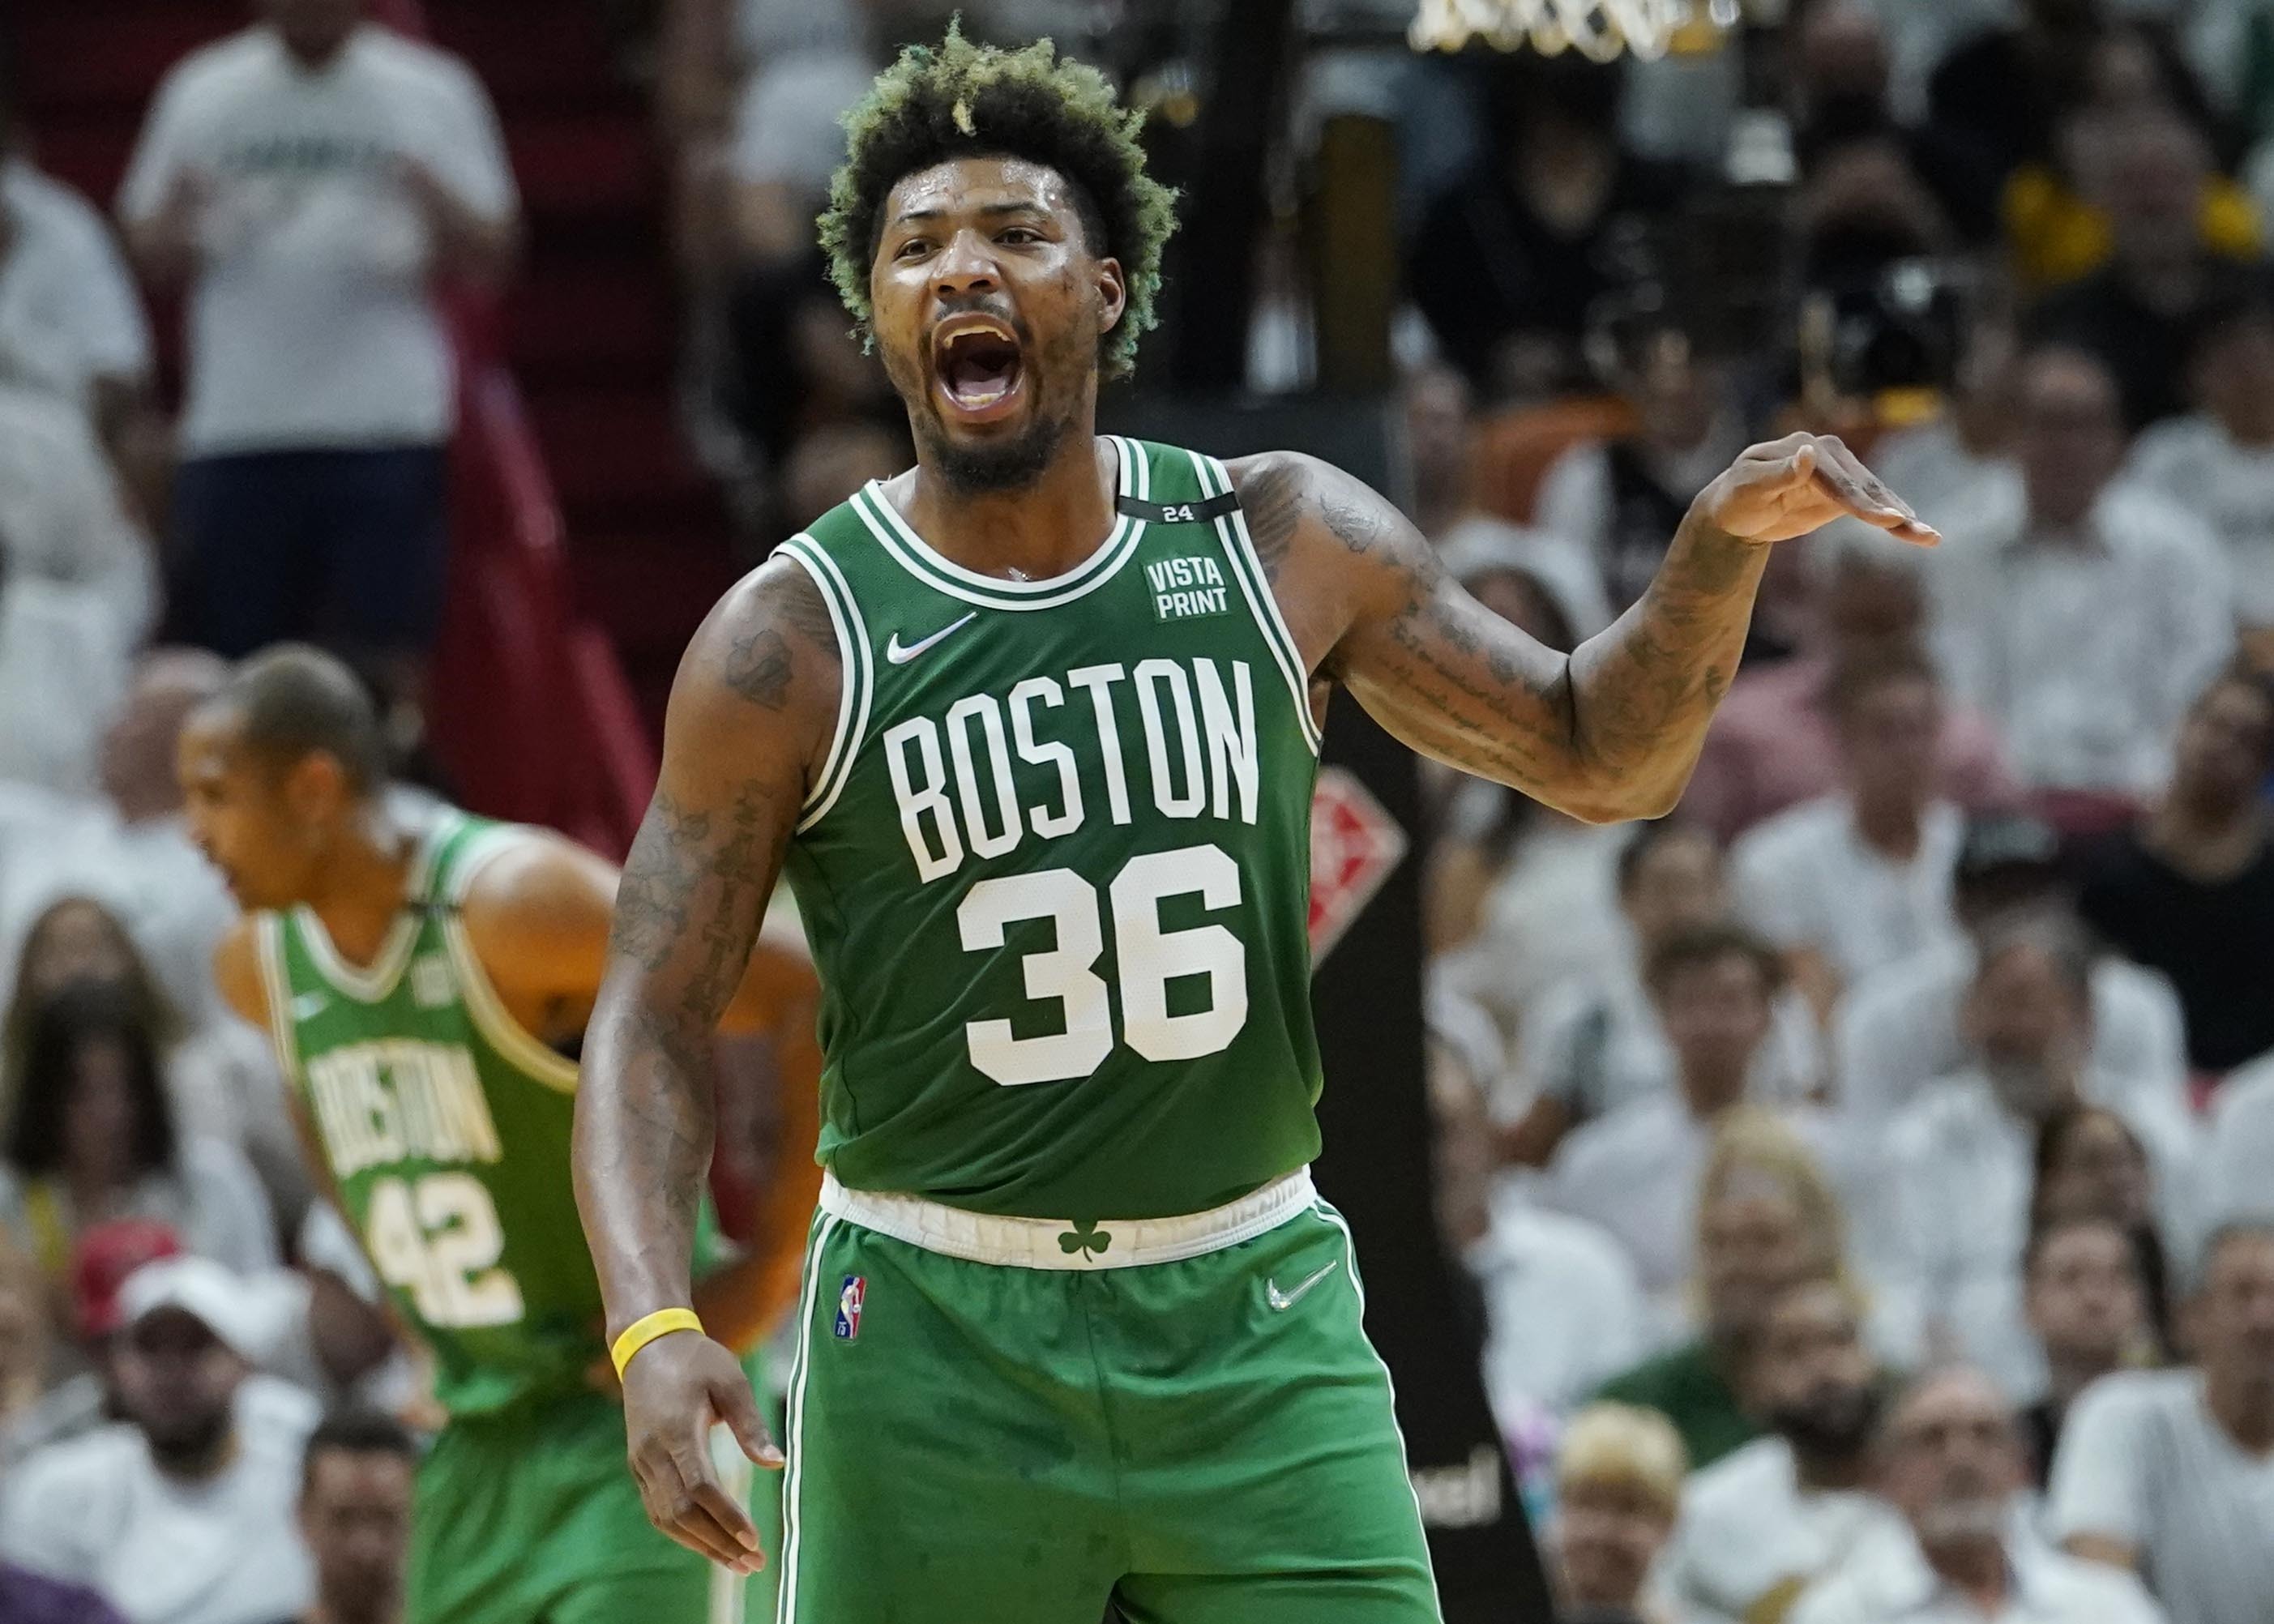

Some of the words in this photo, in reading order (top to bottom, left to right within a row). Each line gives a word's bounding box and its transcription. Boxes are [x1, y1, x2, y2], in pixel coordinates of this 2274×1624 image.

[1148, 557, 1225, 593] VISTA
[1161, 505, 1195, 523] 24
[1156, 588, 1227, 619] PRINT
[883, 657, 1259, 884] BOSTON
[956, 844, 1249, 1086] 36
[308, 1039, 503, 1177] BOSTON
[370, 1172, 525, 1328] 42
